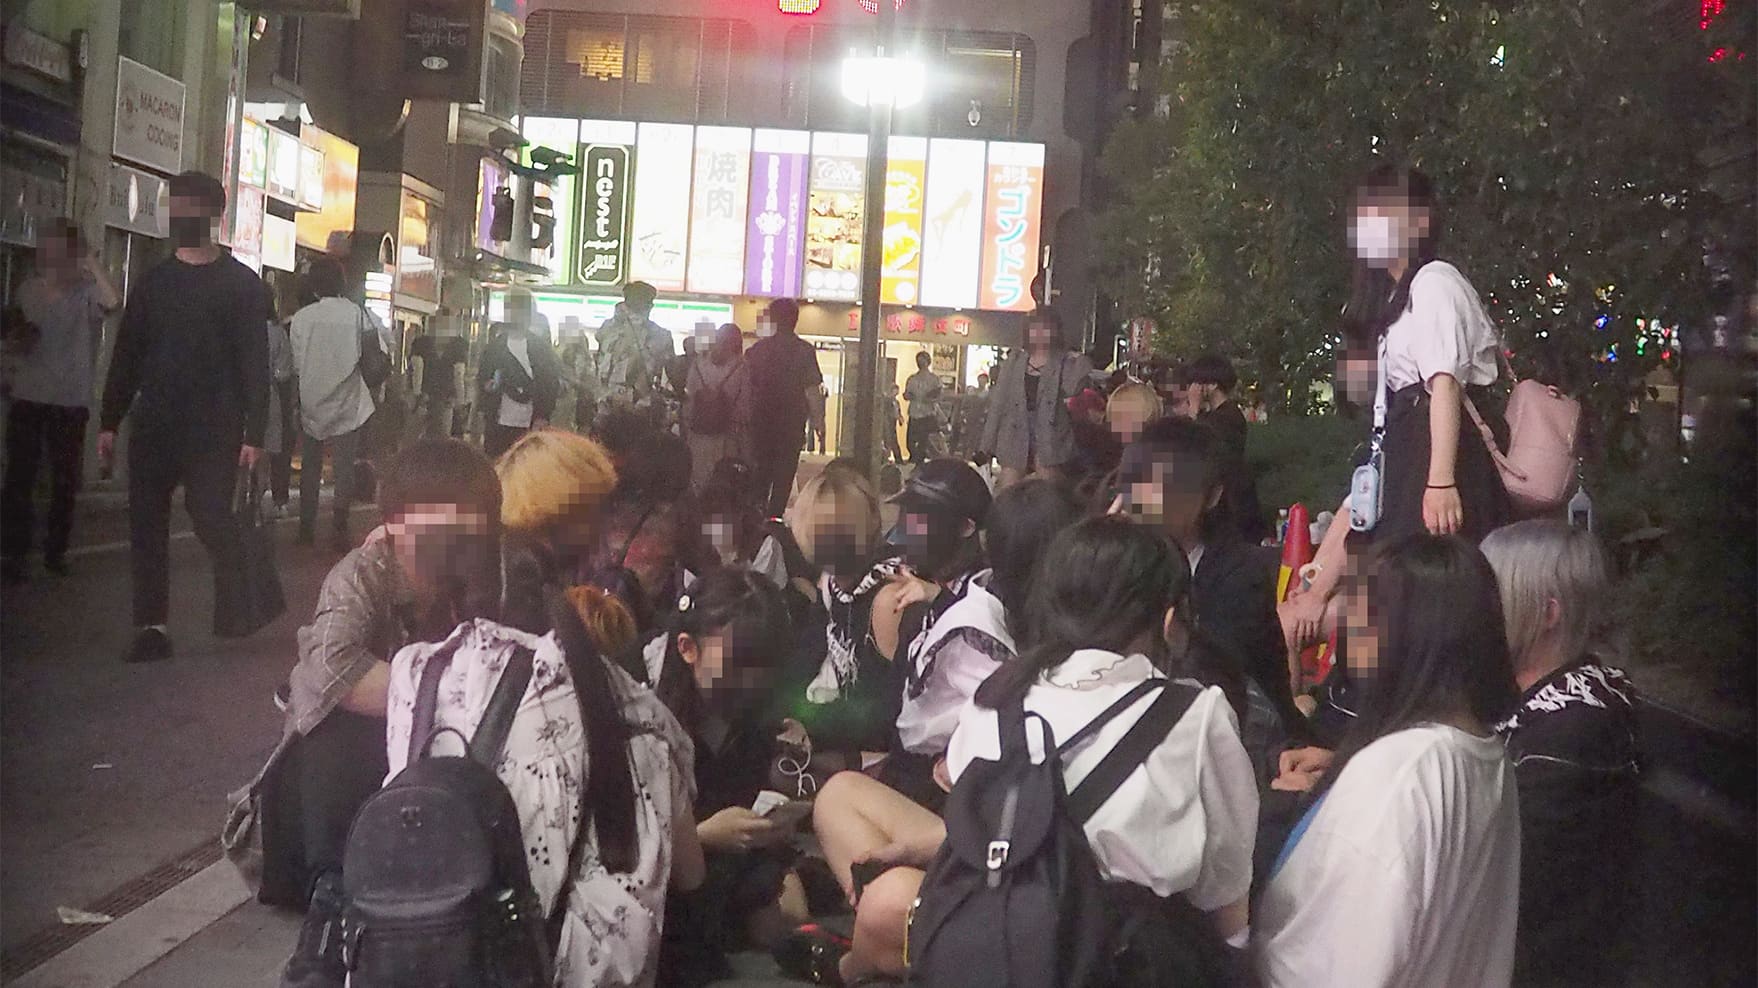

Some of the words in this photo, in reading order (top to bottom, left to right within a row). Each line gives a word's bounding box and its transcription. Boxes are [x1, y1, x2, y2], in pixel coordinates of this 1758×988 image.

[140, 92, 180, 123] MACARON
[595, 157, 615, 238] nest
[707, 152, 737, 218] 焼肉
[993, 186, 1031, 307] ゴンドラ
